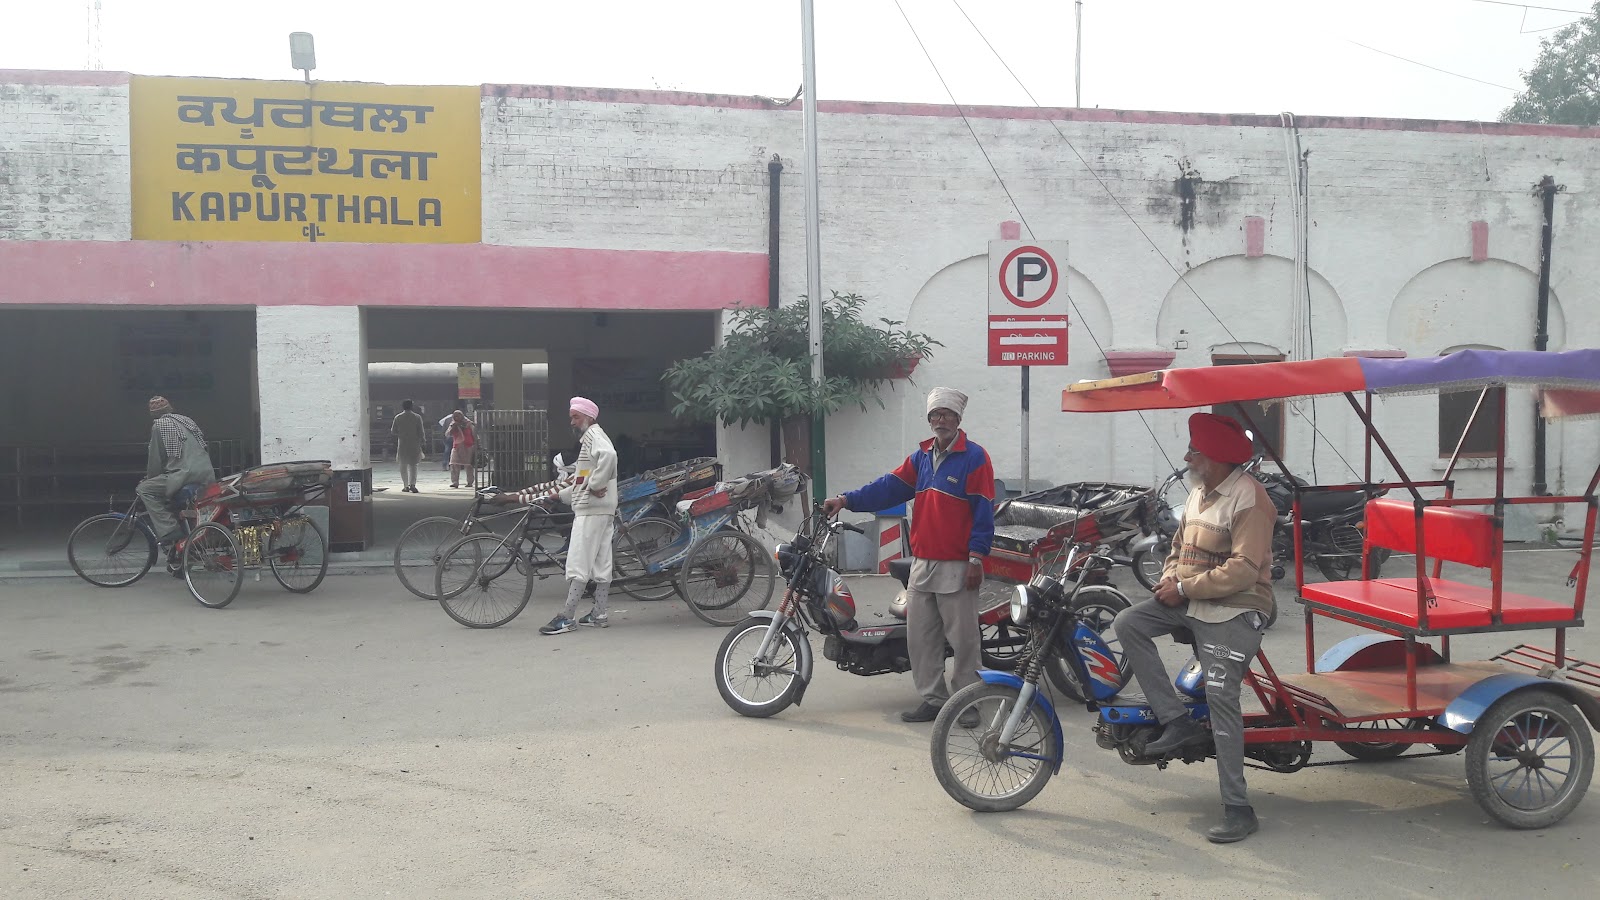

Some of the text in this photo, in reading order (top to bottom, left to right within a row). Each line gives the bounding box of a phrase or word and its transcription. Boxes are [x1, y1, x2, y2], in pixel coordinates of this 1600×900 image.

[176, 143, 438, 190] कपूरथला
[172, 192, 441, 226] KAPURTHALA
[1017, 257, 1047, 297] P
[1016, 352, 1055, 361] PARKING
